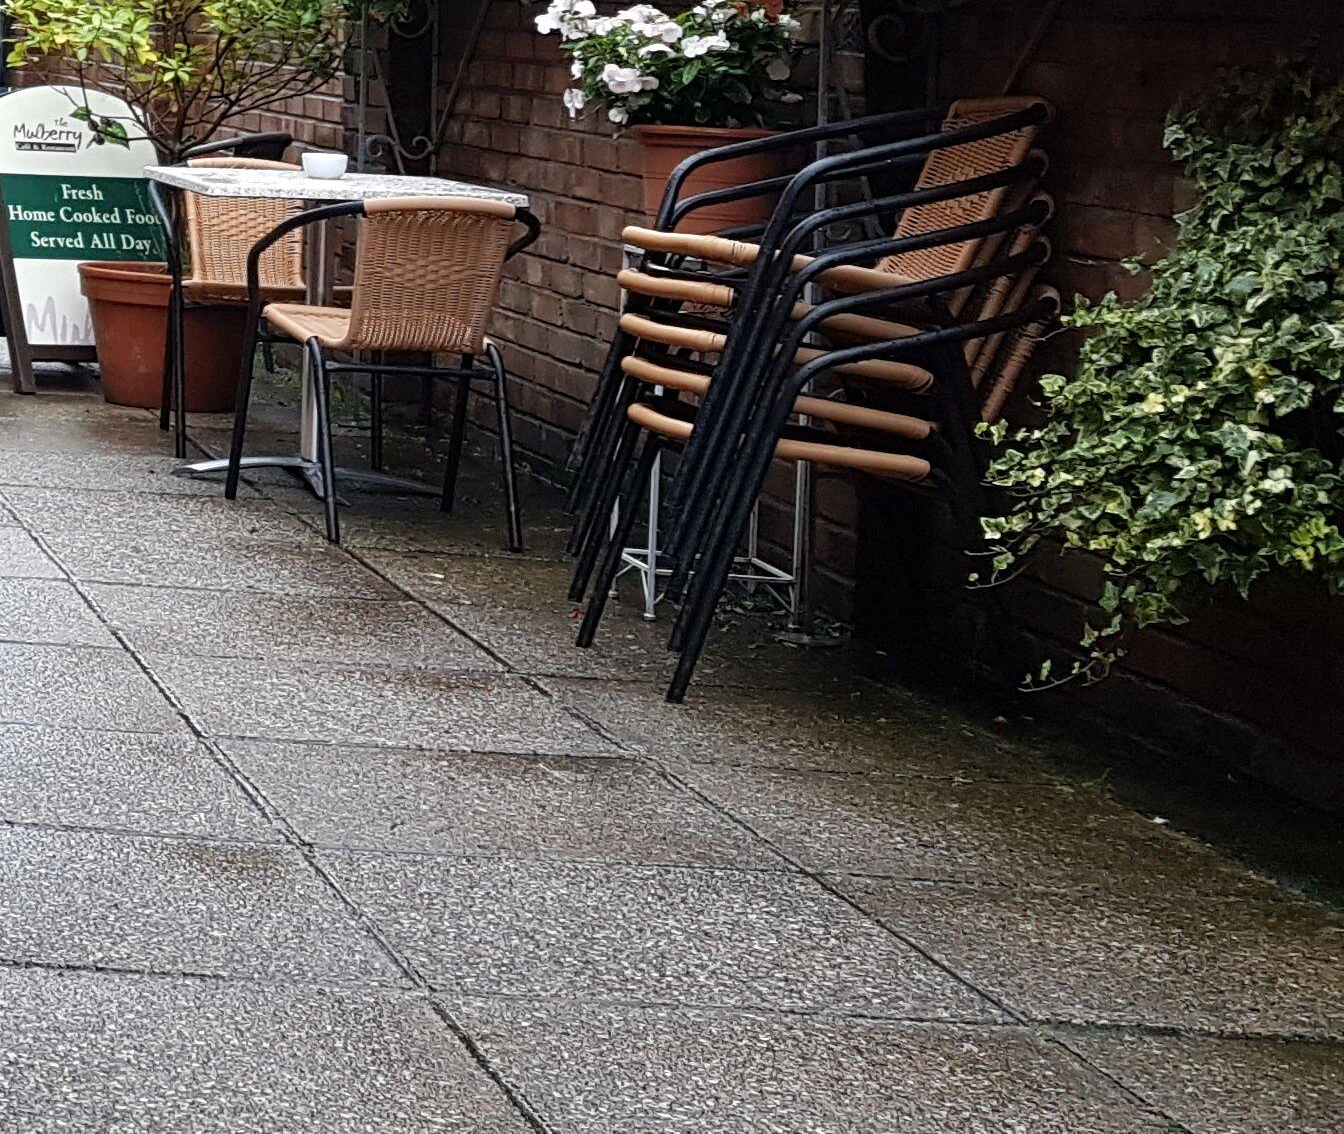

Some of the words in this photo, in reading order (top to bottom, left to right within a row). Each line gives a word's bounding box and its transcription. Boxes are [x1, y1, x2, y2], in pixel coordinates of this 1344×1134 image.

[54, 117, 68, 128] The
[13, 122, 83, 151] Mulberry
[61, 183, 104, 201] Fresh
[7, 204, 56, 222] Home
[59, 206, 122, 225] Cooked
[30, 231, 84, 249] Served
[90, 232, 117, 250] All
[120, 233, 152, 255] Day
